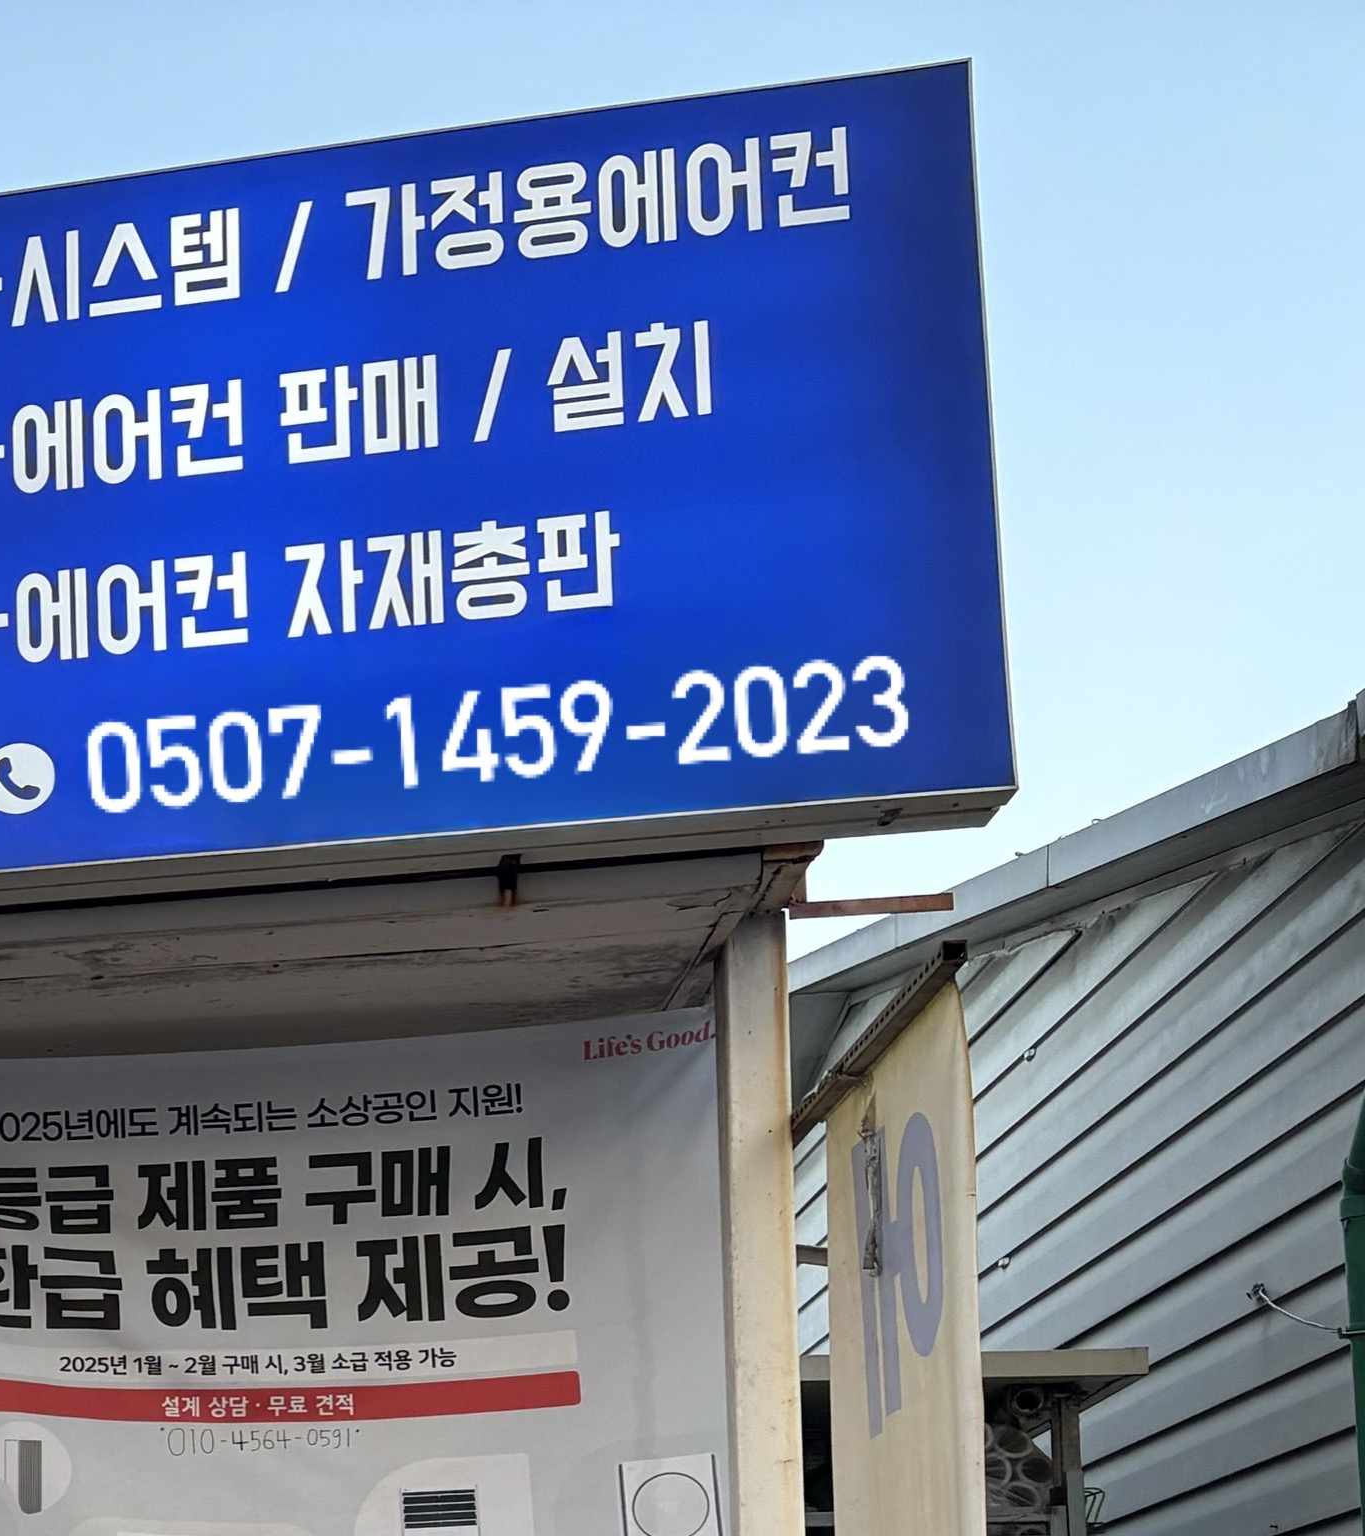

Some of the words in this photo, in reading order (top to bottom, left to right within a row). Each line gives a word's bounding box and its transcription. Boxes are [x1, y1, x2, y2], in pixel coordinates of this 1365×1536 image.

[344, 125, 852, 281] 가정용에어컨
[277, 353, 439, 465] 판매
[545, 318, 713, 434] 설치
[284, 510, 621, 639] 자재총판
[86, 653, 910, 815] 0507-1459-2023
[584, 1034, 642, 1061] Life's
[165, 1099, 298, 1139] 계속되는
[306, 1089, 438, 1128] 소상공인
[448, 1082, 526, 1118] 지원!
[136, 1155, 281, 1234] 제품
[304, 1146, 450, 1227] 구매
[473, 1136, 568, 1215] 시,
[145, 1240, 325, 1331] 혜택
[355, 1223, 572, 1325] 제공!
[59, 1354, 127, 1376] 2025년
[132, 1354, 163, 1376] 1월
[184, 1354, 218, 1376] 2월
[221, 1353, 260, 1375] 구매
[265, 1353, 289, 1376] 시,
[293, 1352, 326, 1374] 3월
[331, 1351, 369, 1373] 소급
[374, 1348, 414, 1373] 적용
[418, 1346, 457, 1371] 가능
[161, 1395, 201, 1418] 설계
[208, 1395, 249, 1418] 상담
[266, 1395, 308, 1416] 무료
[315, 1393, 355, 1417] 견적
[167, 1427, 352, 1457] 010-4564-0591
